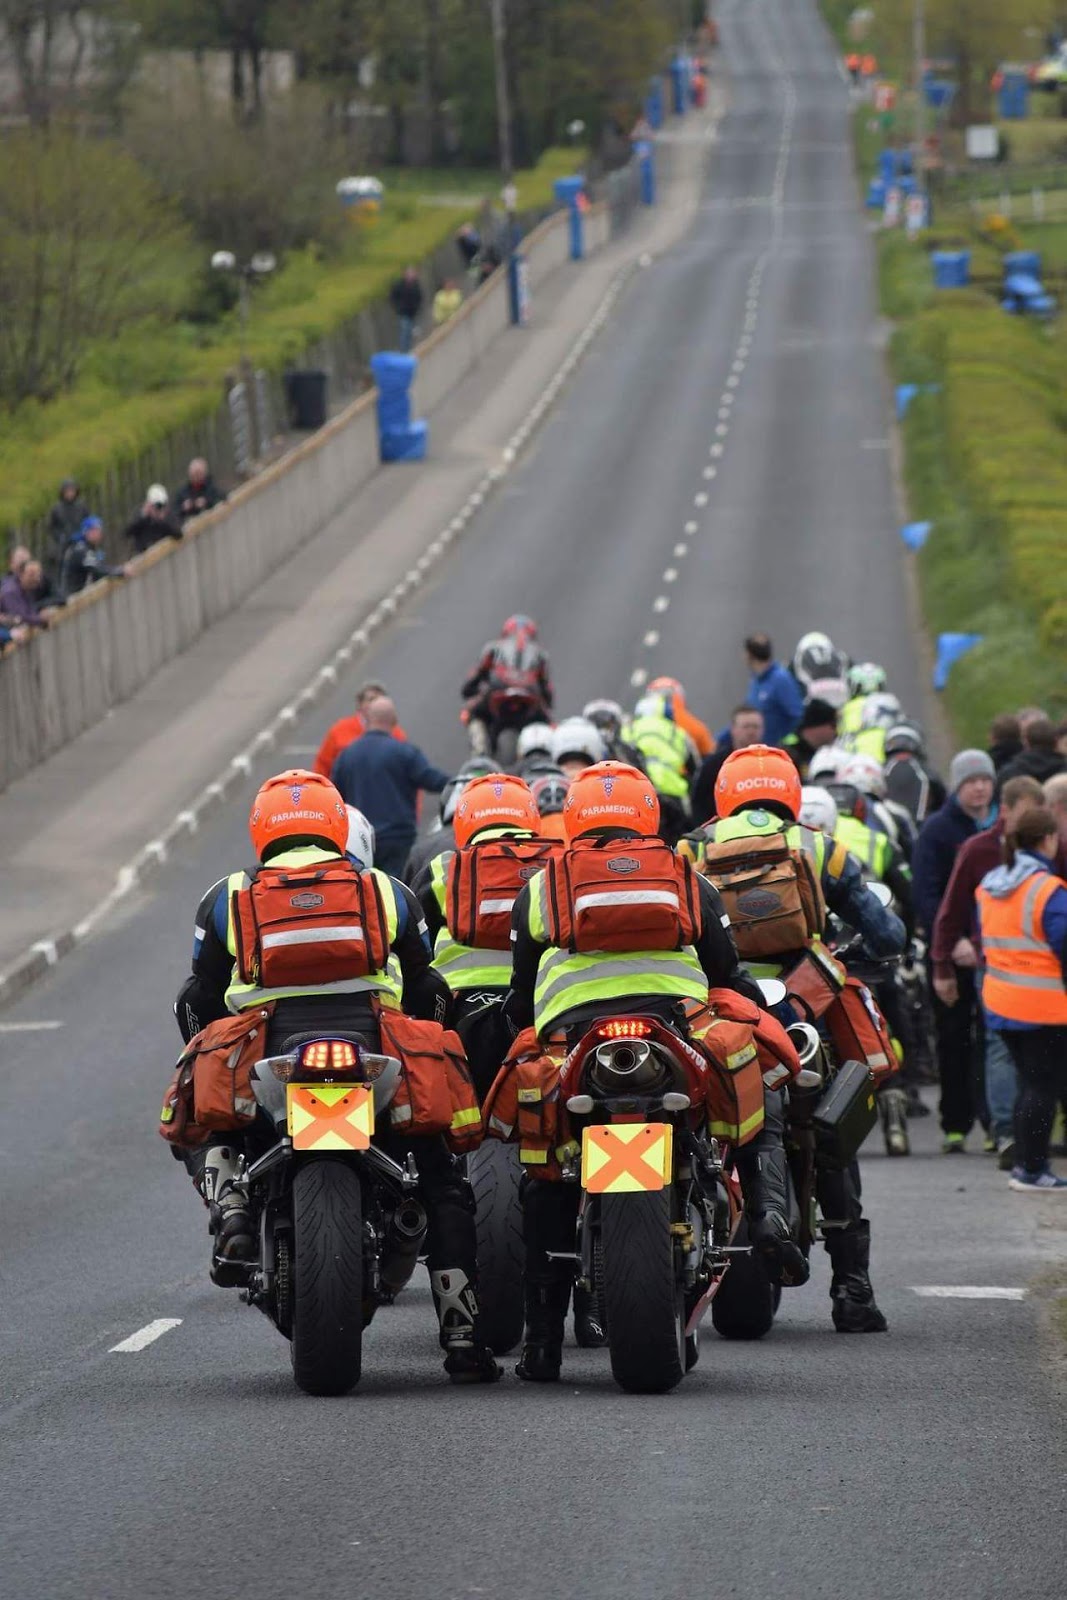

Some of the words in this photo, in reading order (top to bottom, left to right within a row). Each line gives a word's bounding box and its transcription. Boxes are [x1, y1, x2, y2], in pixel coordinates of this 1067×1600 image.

[736, 777, 786, 791] DOCTOR
[271, 810, 325, 824] PARAMEDIC
[474, 807, 525, 819] PARAMEDIC
[581, 805, 635, 817] PARAMEDIC
[185, 1002, 200, 1039] ST
